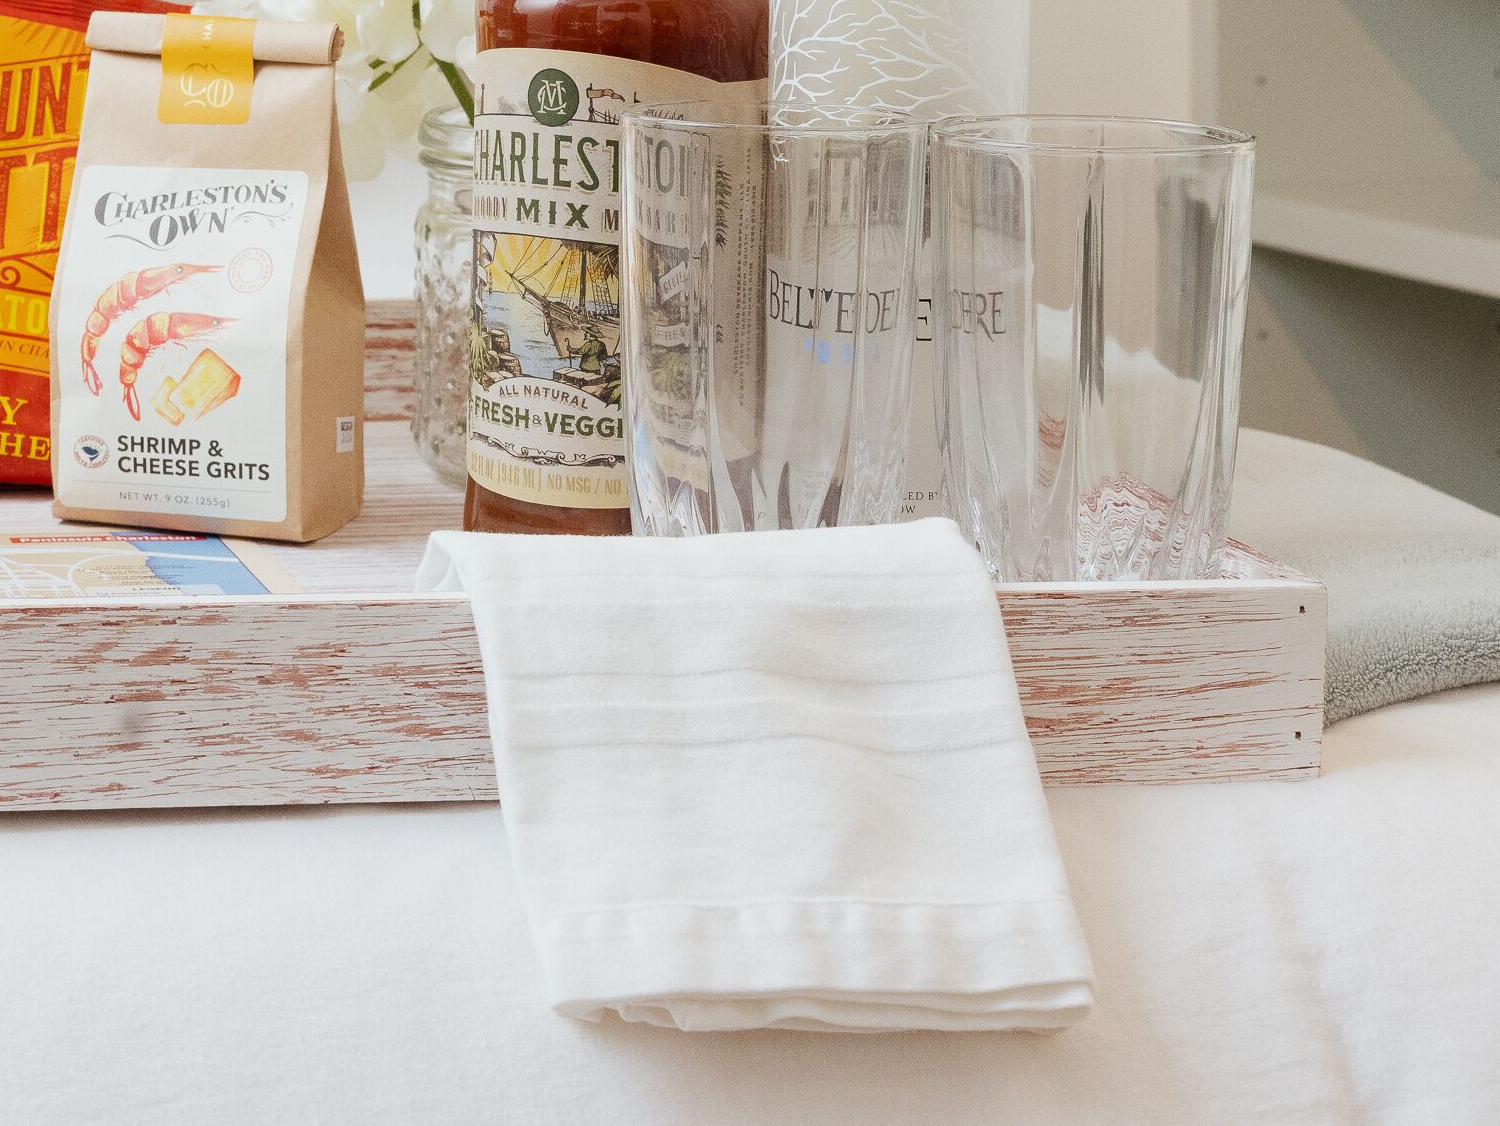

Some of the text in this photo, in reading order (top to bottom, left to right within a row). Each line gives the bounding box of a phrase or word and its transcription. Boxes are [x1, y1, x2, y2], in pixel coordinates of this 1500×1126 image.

[94, 179, 289, 227] CHARLESTON'S
[515, 197, 591, 230] MIX
[149, 207, 230, 247] OWN
[499, 384, 589, 410] ALL NATURAL
[473, 396, 531, 431] FRESH
[531, 414, 543, 427] &
[116, 435, 224, 458] SHRIMP &
[116, 456, 201, 478] CHEESE
[206, 461, 271, 482] GRITS
[546, 471, 563, 491] NO
[565, 475, 592, 494] MSG
[604, 477, 622, 496] NO
[119, 491, 140, 502] NET
[142, 492, 163, 503] WT.
[164, 493, 172, 504] 9
[195, 496, 231, 509] (255g)
